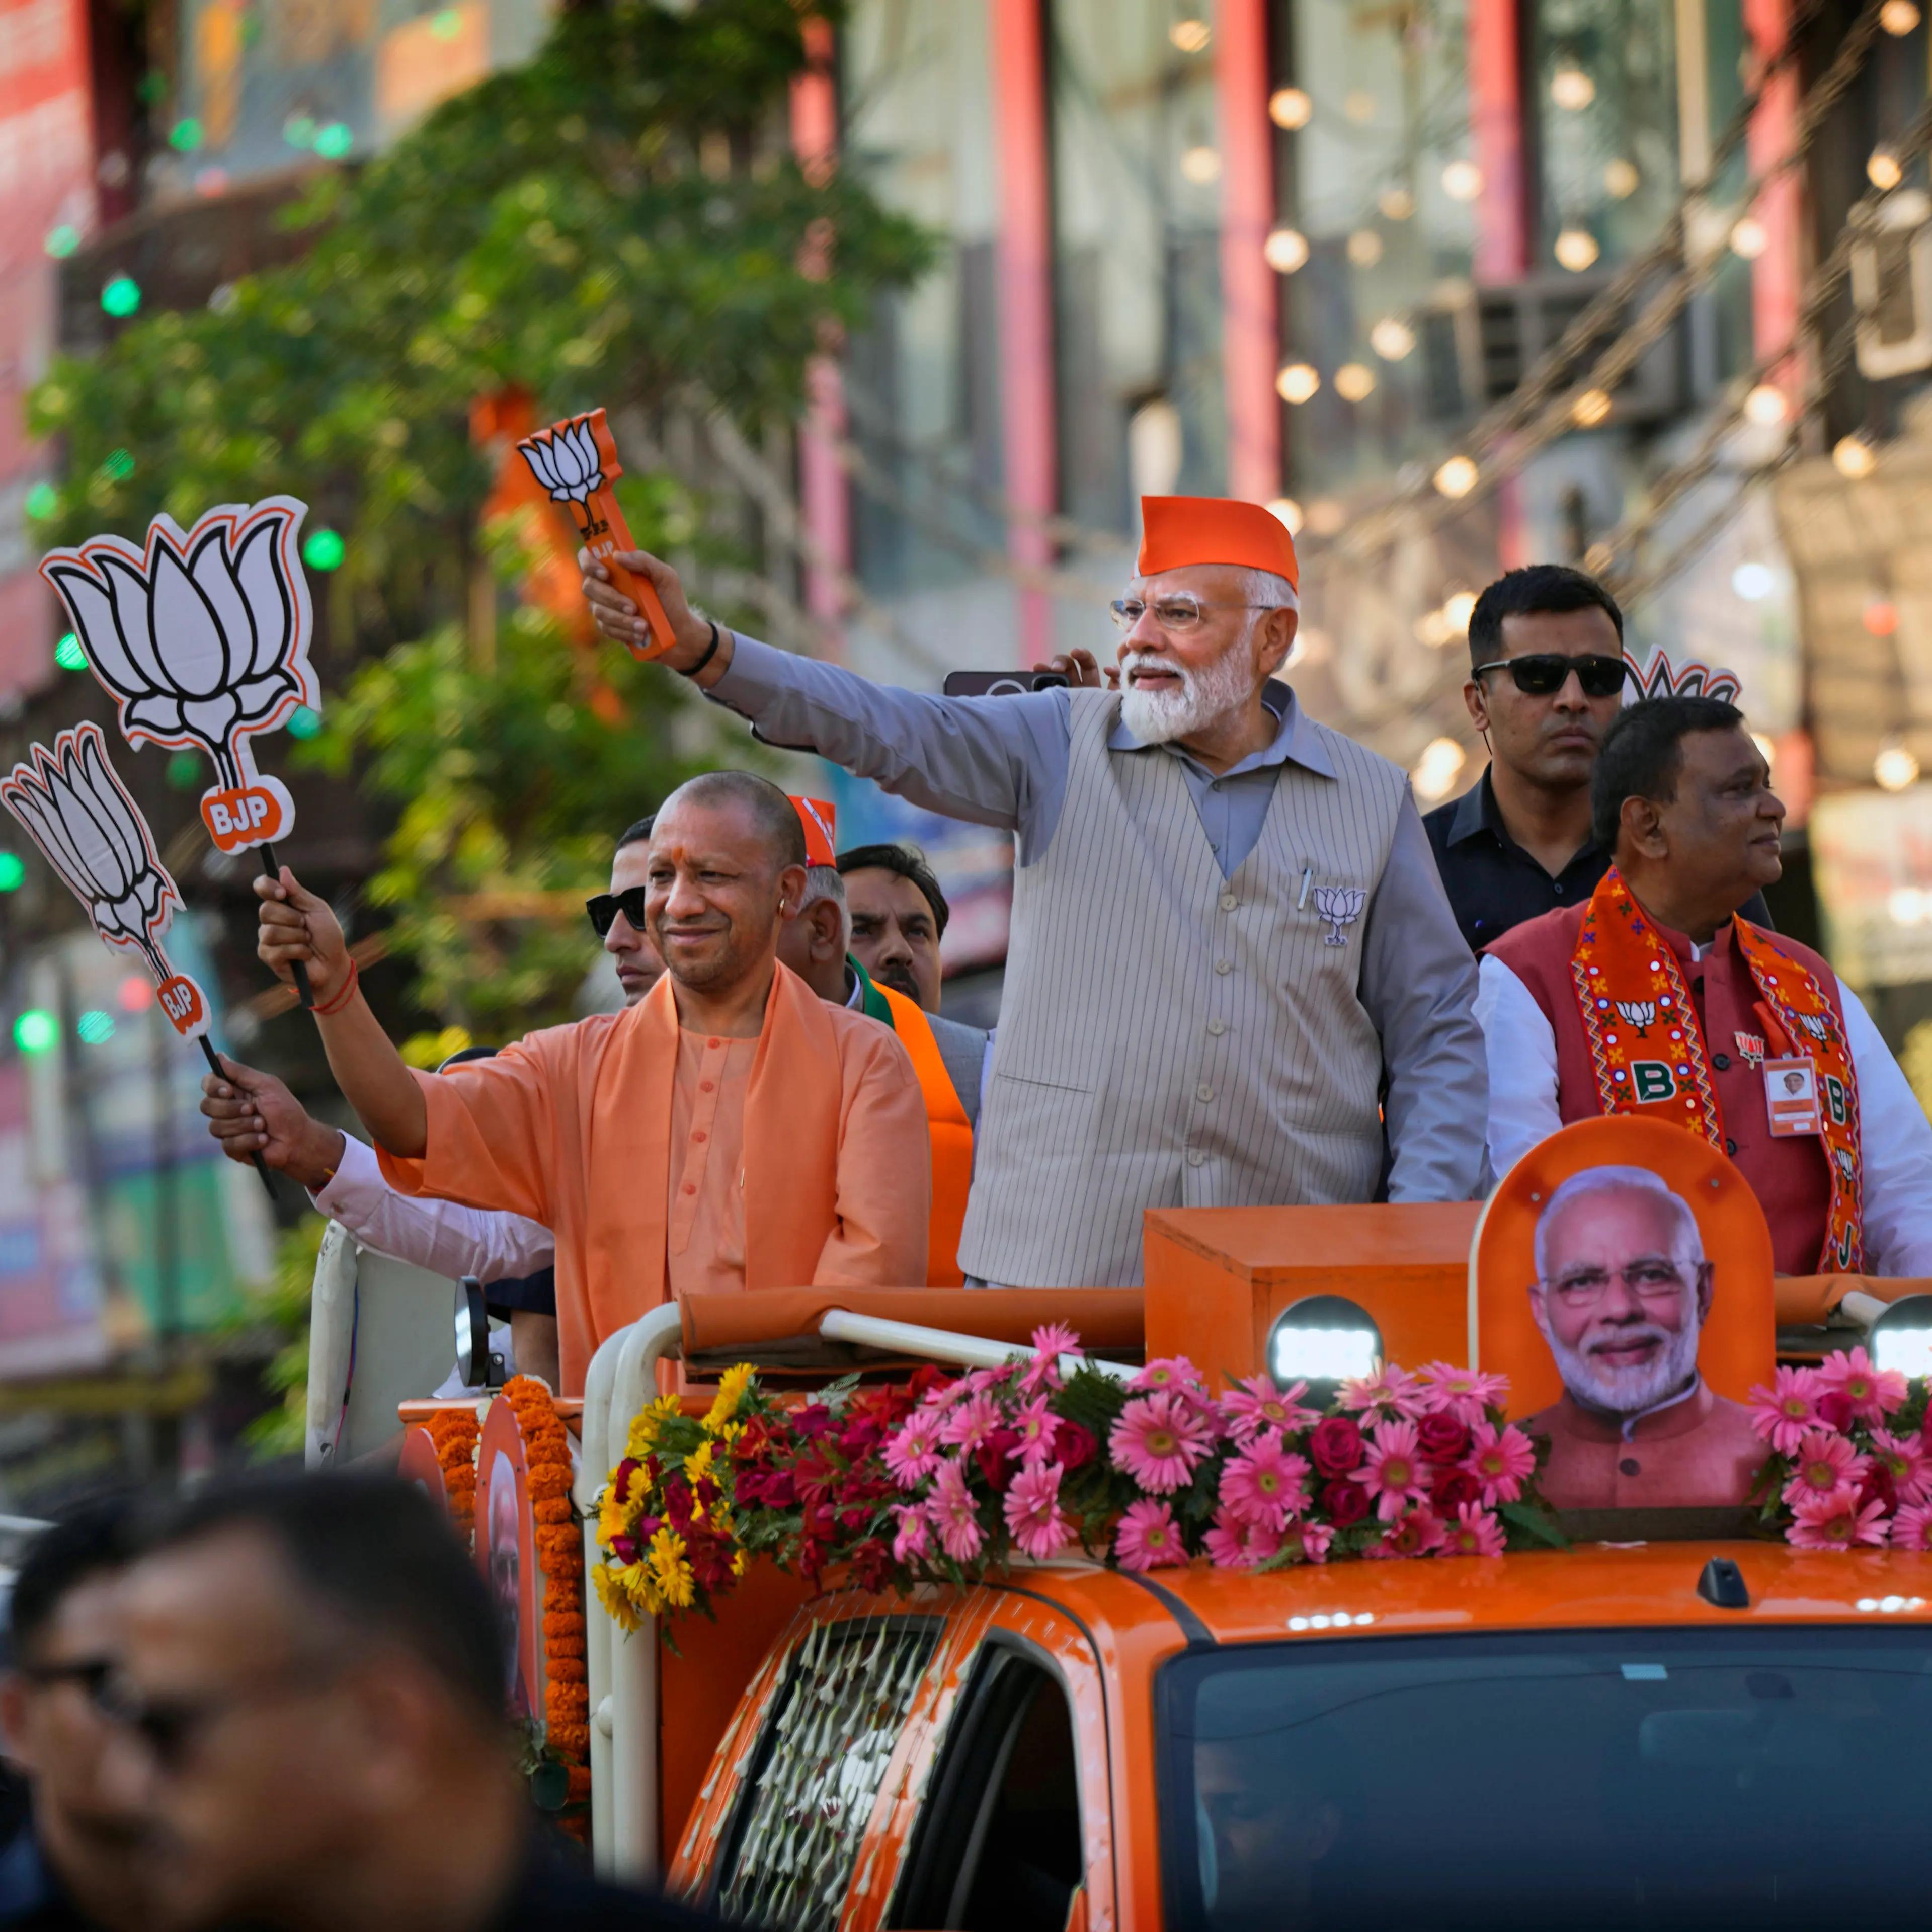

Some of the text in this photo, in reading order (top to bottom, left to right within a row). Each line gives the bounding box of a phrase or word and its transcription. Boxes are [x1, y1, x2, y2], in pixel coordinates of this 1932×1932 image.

[209, 795, 268, 836] BJP
[162, 983, 193, 1021] BJP
[1630, 1060, 1677, 1104] B
[1824, 1074, 1846, 1126] B
[1837, 1220, 1855, 1270] J
